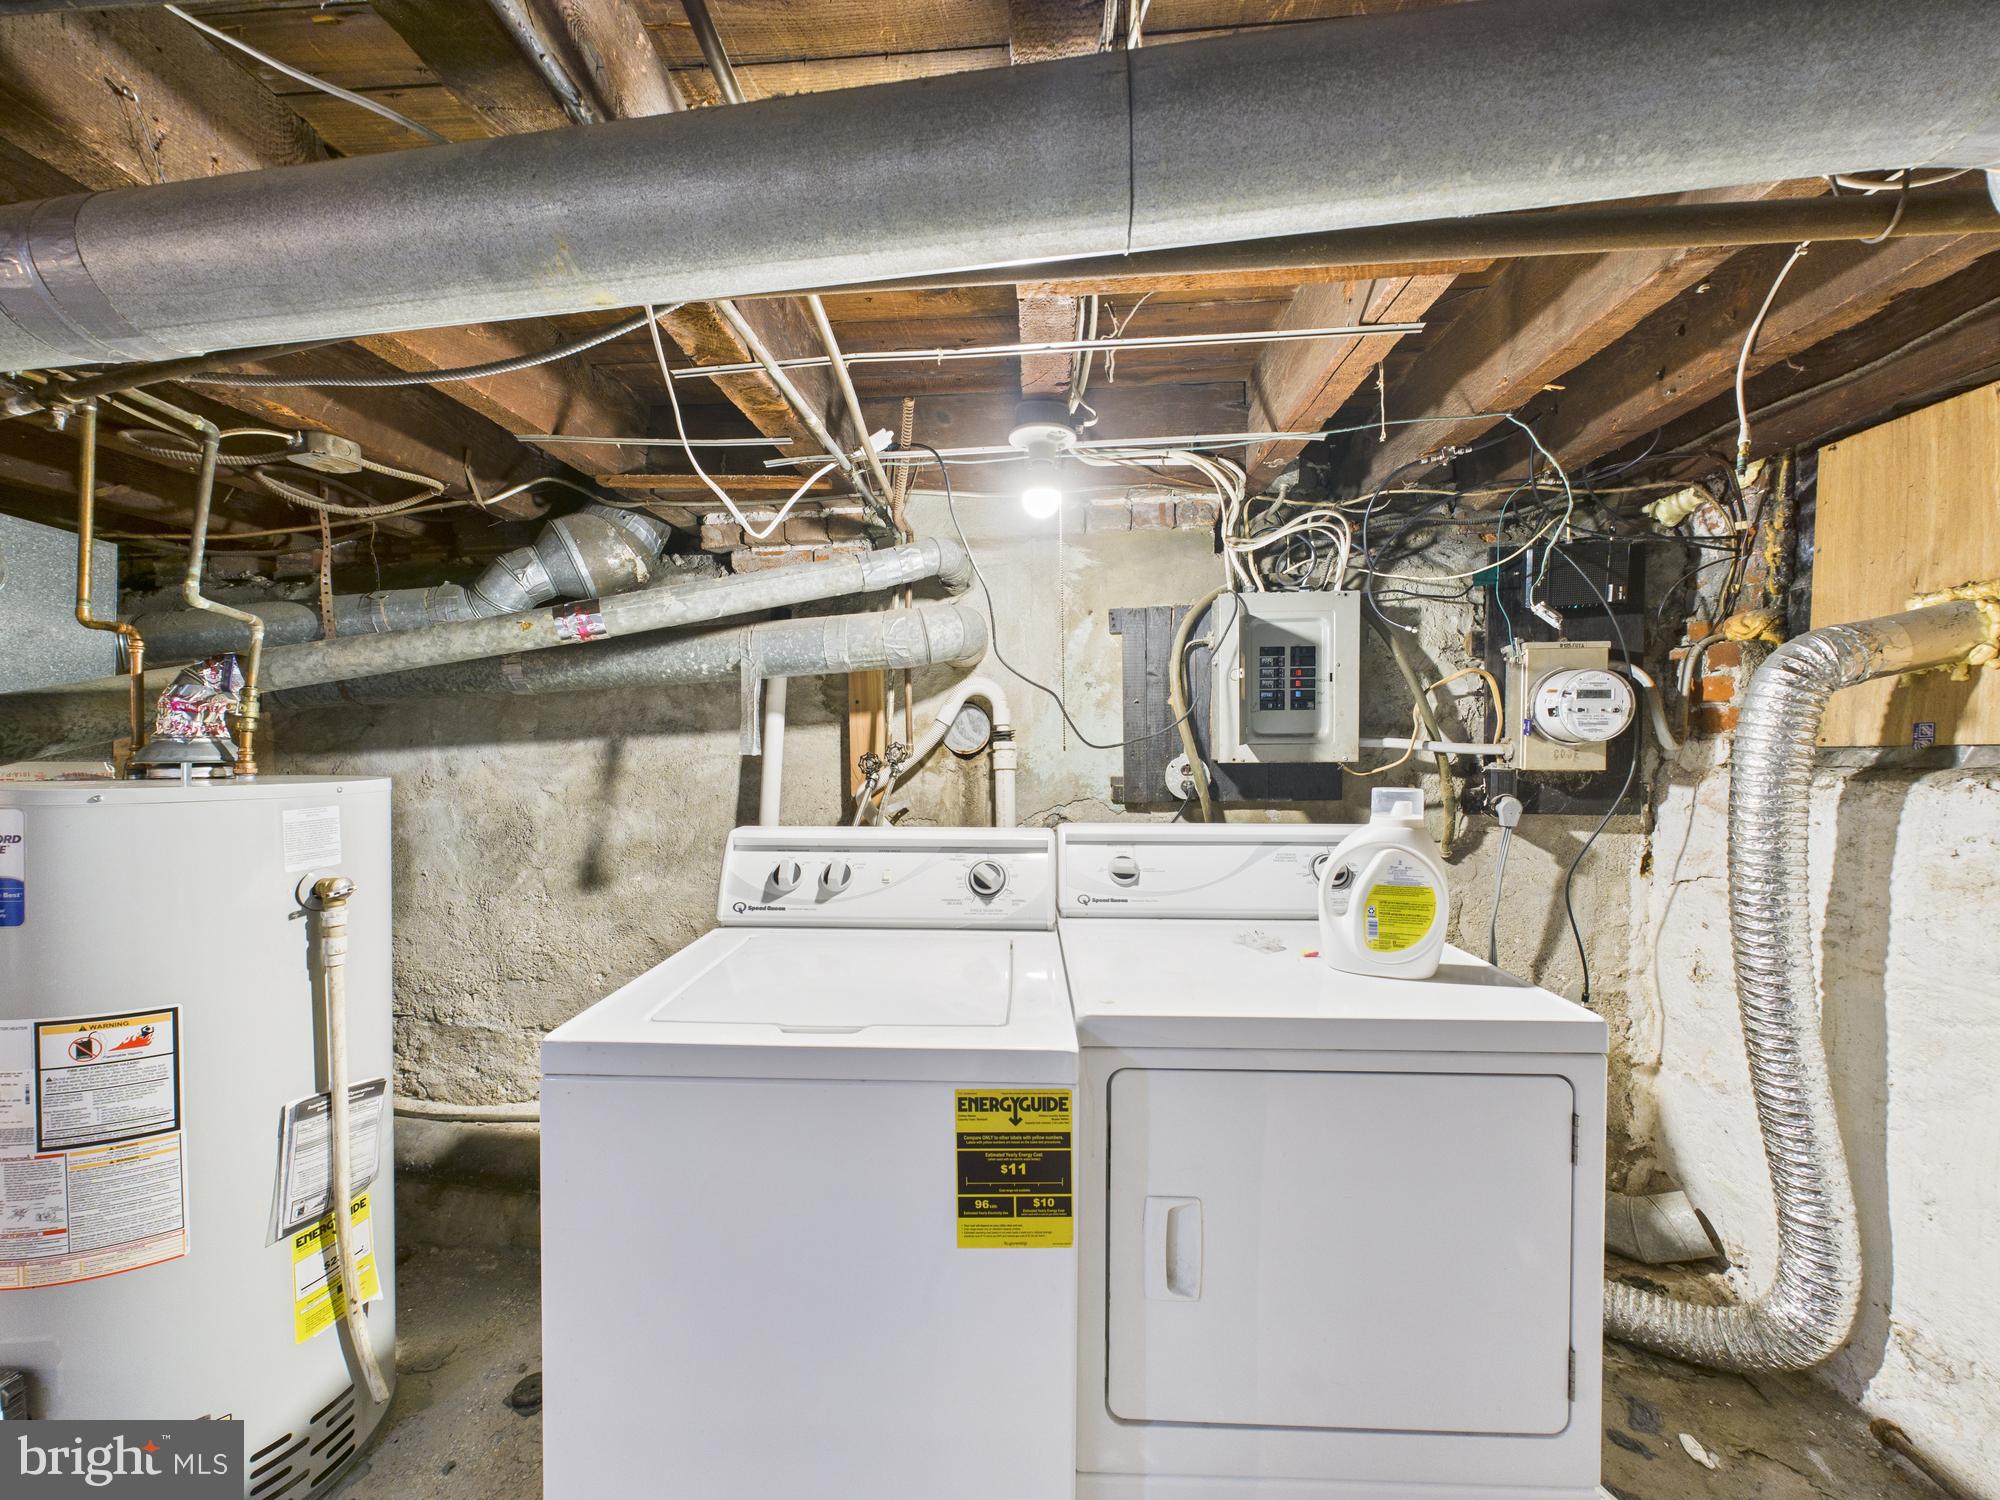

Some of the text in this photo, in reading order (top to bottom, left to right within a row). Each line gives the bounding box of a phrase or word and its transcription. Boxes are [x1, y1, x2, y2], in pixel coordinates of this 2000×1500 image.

[89, 1021, 129, 1030] WARNING
[958, 1096, 1069, 1113] ENERGYGUIDE
[1000, 1163, 1026, 1175] $11
[974, 1200, 990, 1209] 96
[1033, 1198, 1055, 1207] $10
